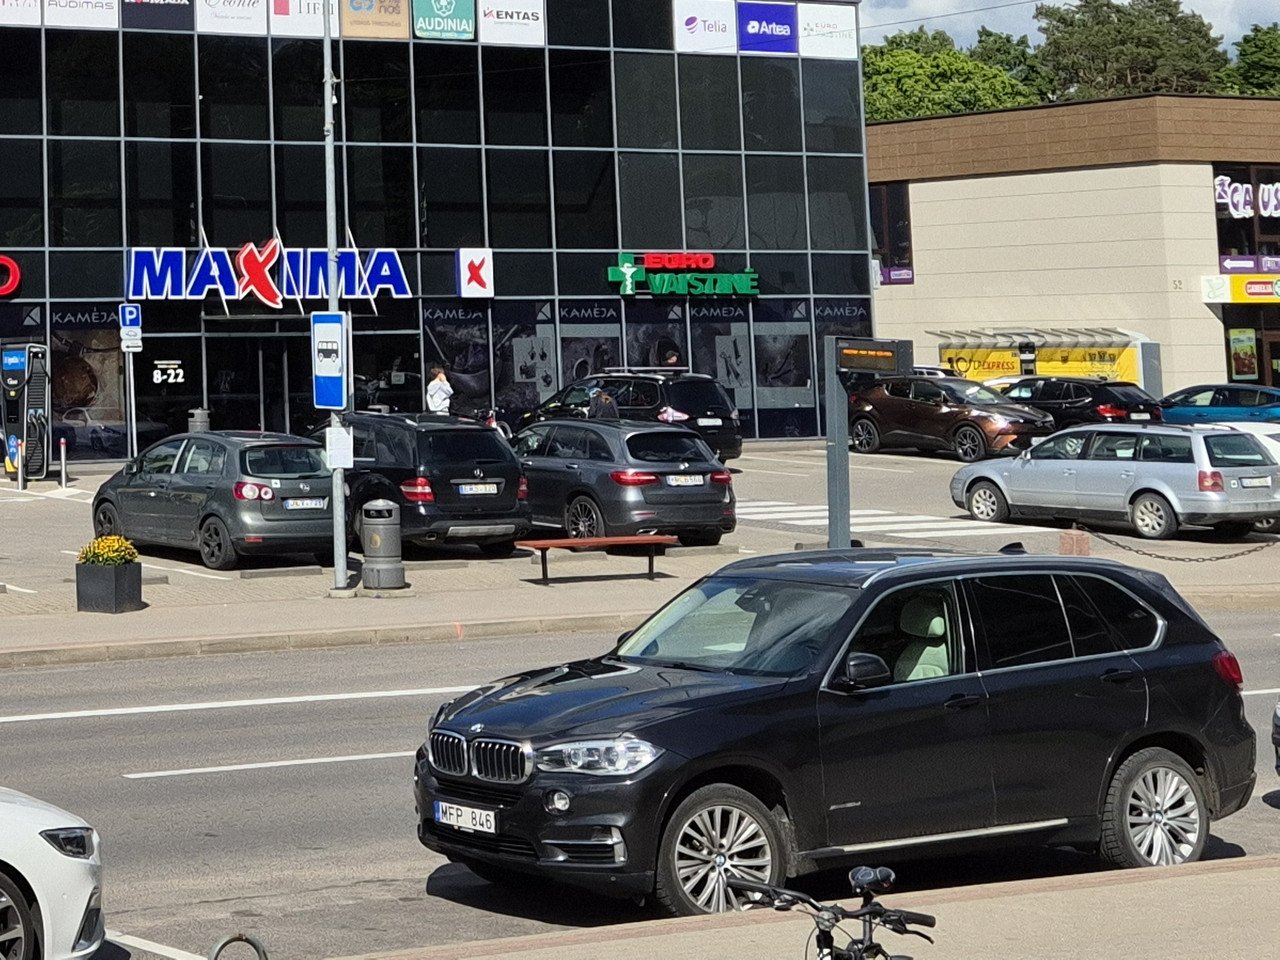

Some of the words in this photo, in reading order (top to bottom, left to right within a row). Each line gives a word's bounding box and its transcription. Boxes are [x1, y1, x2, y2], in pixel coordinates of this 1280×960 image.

[701, 19, 728, 34] Telia
[760, 19, 792, 37] Artea
[642, 252, 717, 270] EURO
[128, 236, 413, 309] MAXIMA
[124, 306, 138, 326] P
[560, 302, 618, 319] KAMĖJA
[152, 368, 185, 384] 8-22
[441, 804, 463, 823] MFP
[471, 811, 492, 829] 846
